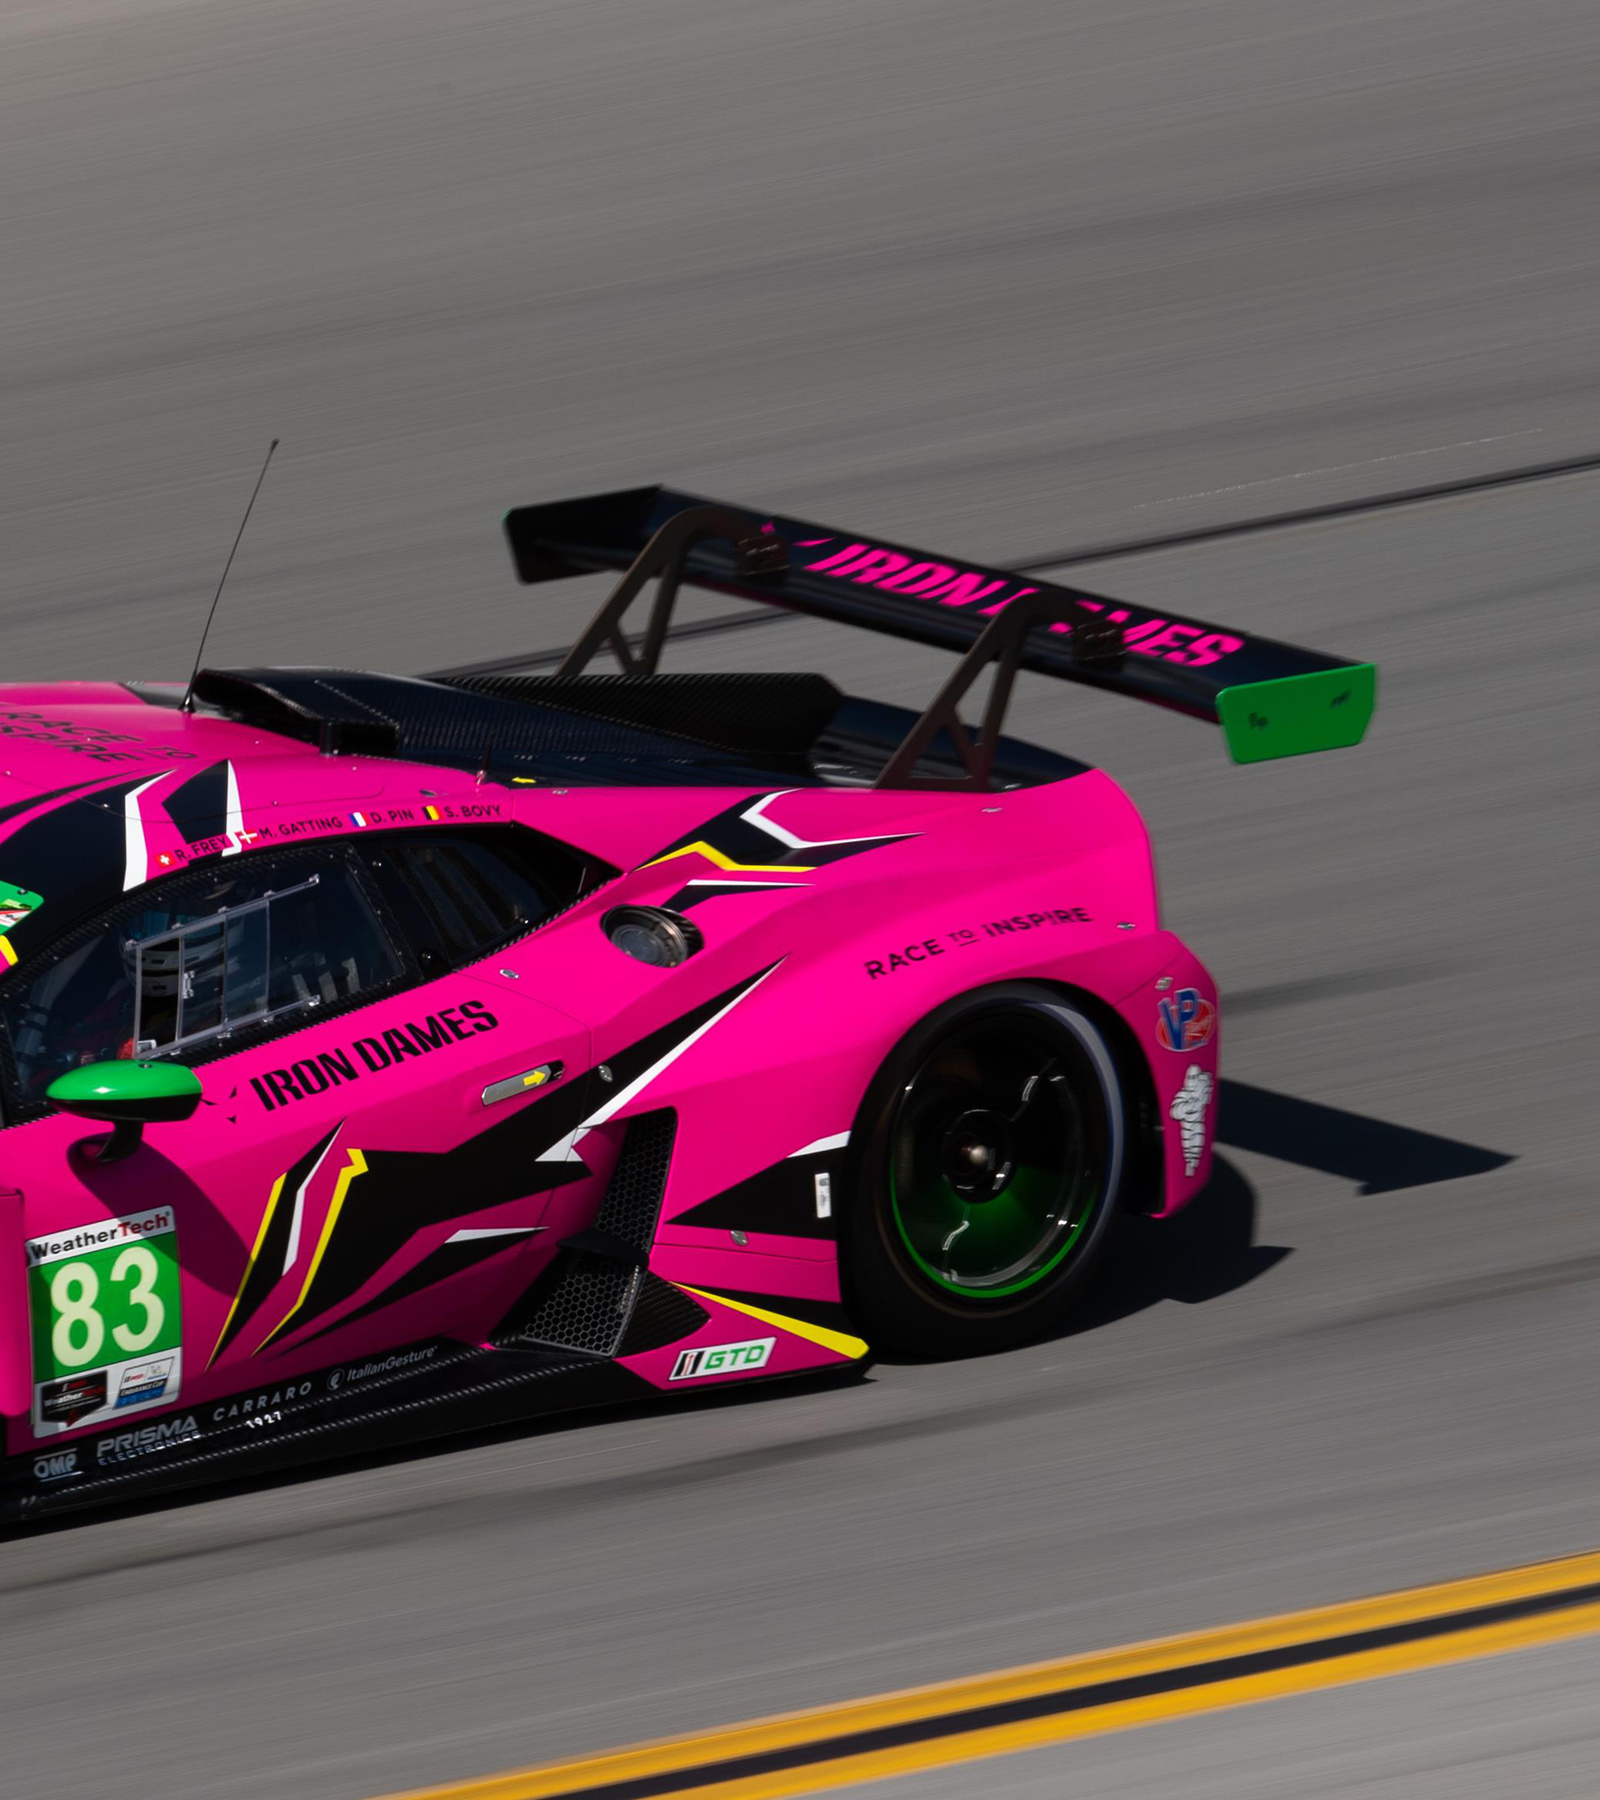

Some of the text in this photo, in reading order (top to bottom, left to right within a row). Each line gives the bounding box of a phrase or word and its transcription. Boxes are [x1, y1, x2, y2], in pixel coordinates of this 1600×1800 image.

[803, 543, 1010, 607] IRON
[369, 808, 415, 824] D. PIN
[444, 803, 502, 818] S. BOVY
[258, 815, 344, 840] M. GATTING
[174, 835, 231, 862] R. FREY
[863, 907, 1094, 980] RACE TO INSPIRE
[249, 1000, 499, 1112] IRON DAMES
[51, 1246, 166, 1368] 83
[704, 1344, 765, 1370] GTD
[212, 1381, 312, 1422] CARRARO
[246, 1410, 282, 1429] 1927
[97, 1415, 198, 1458] PRISMA
[33, 1452, 78, 1480] OMP
